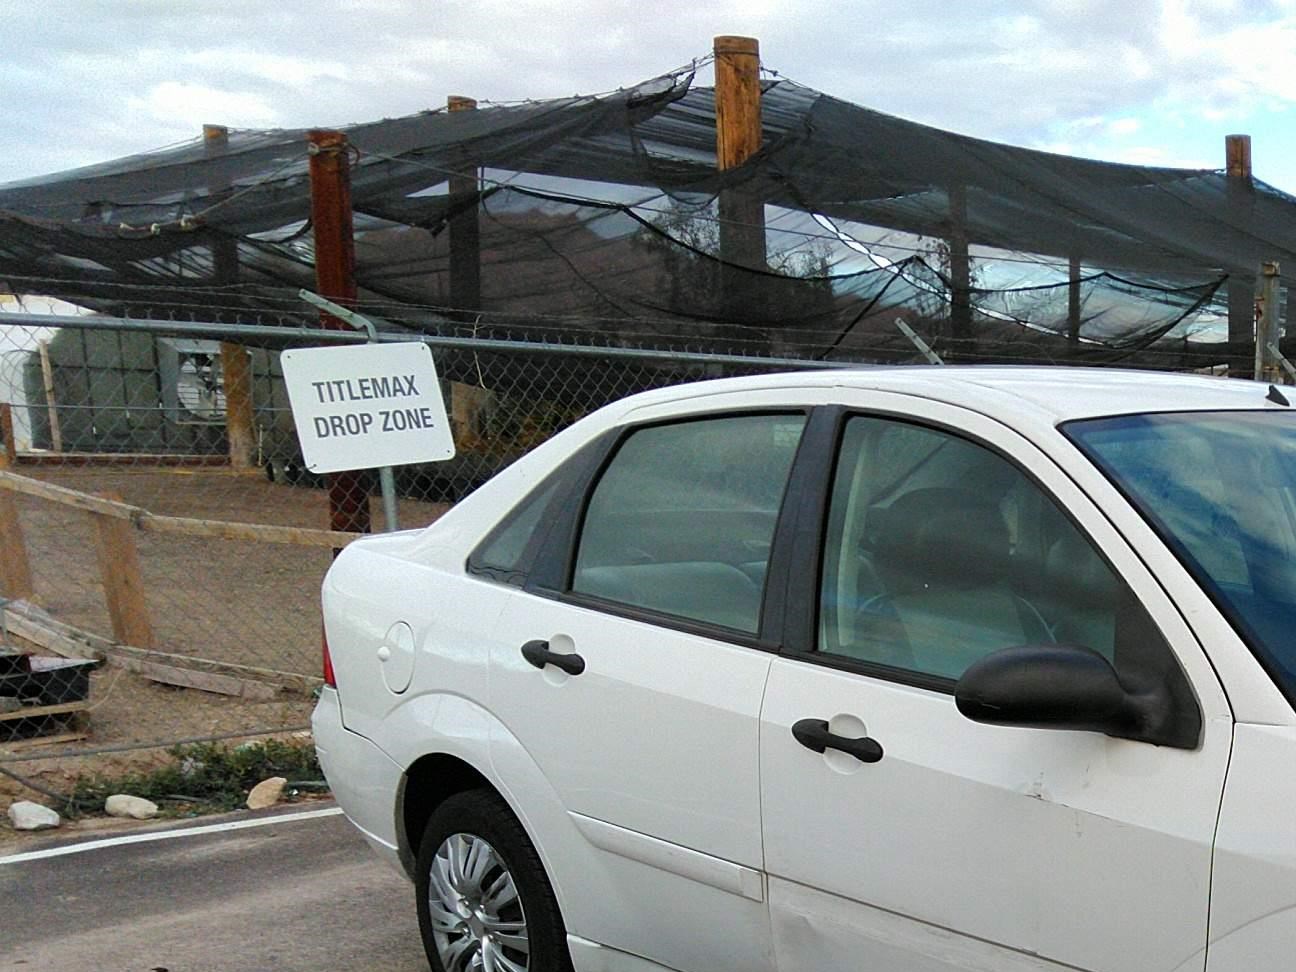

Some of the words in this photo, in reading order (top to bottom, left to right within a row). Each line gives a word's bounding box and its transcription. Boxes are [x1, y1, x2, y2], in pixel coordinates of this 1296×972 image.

[312, 375, 420, 403] TITLEMAX
[313, 412, 373, 438] DROP
[379, 407, 434, 432] ZONE
